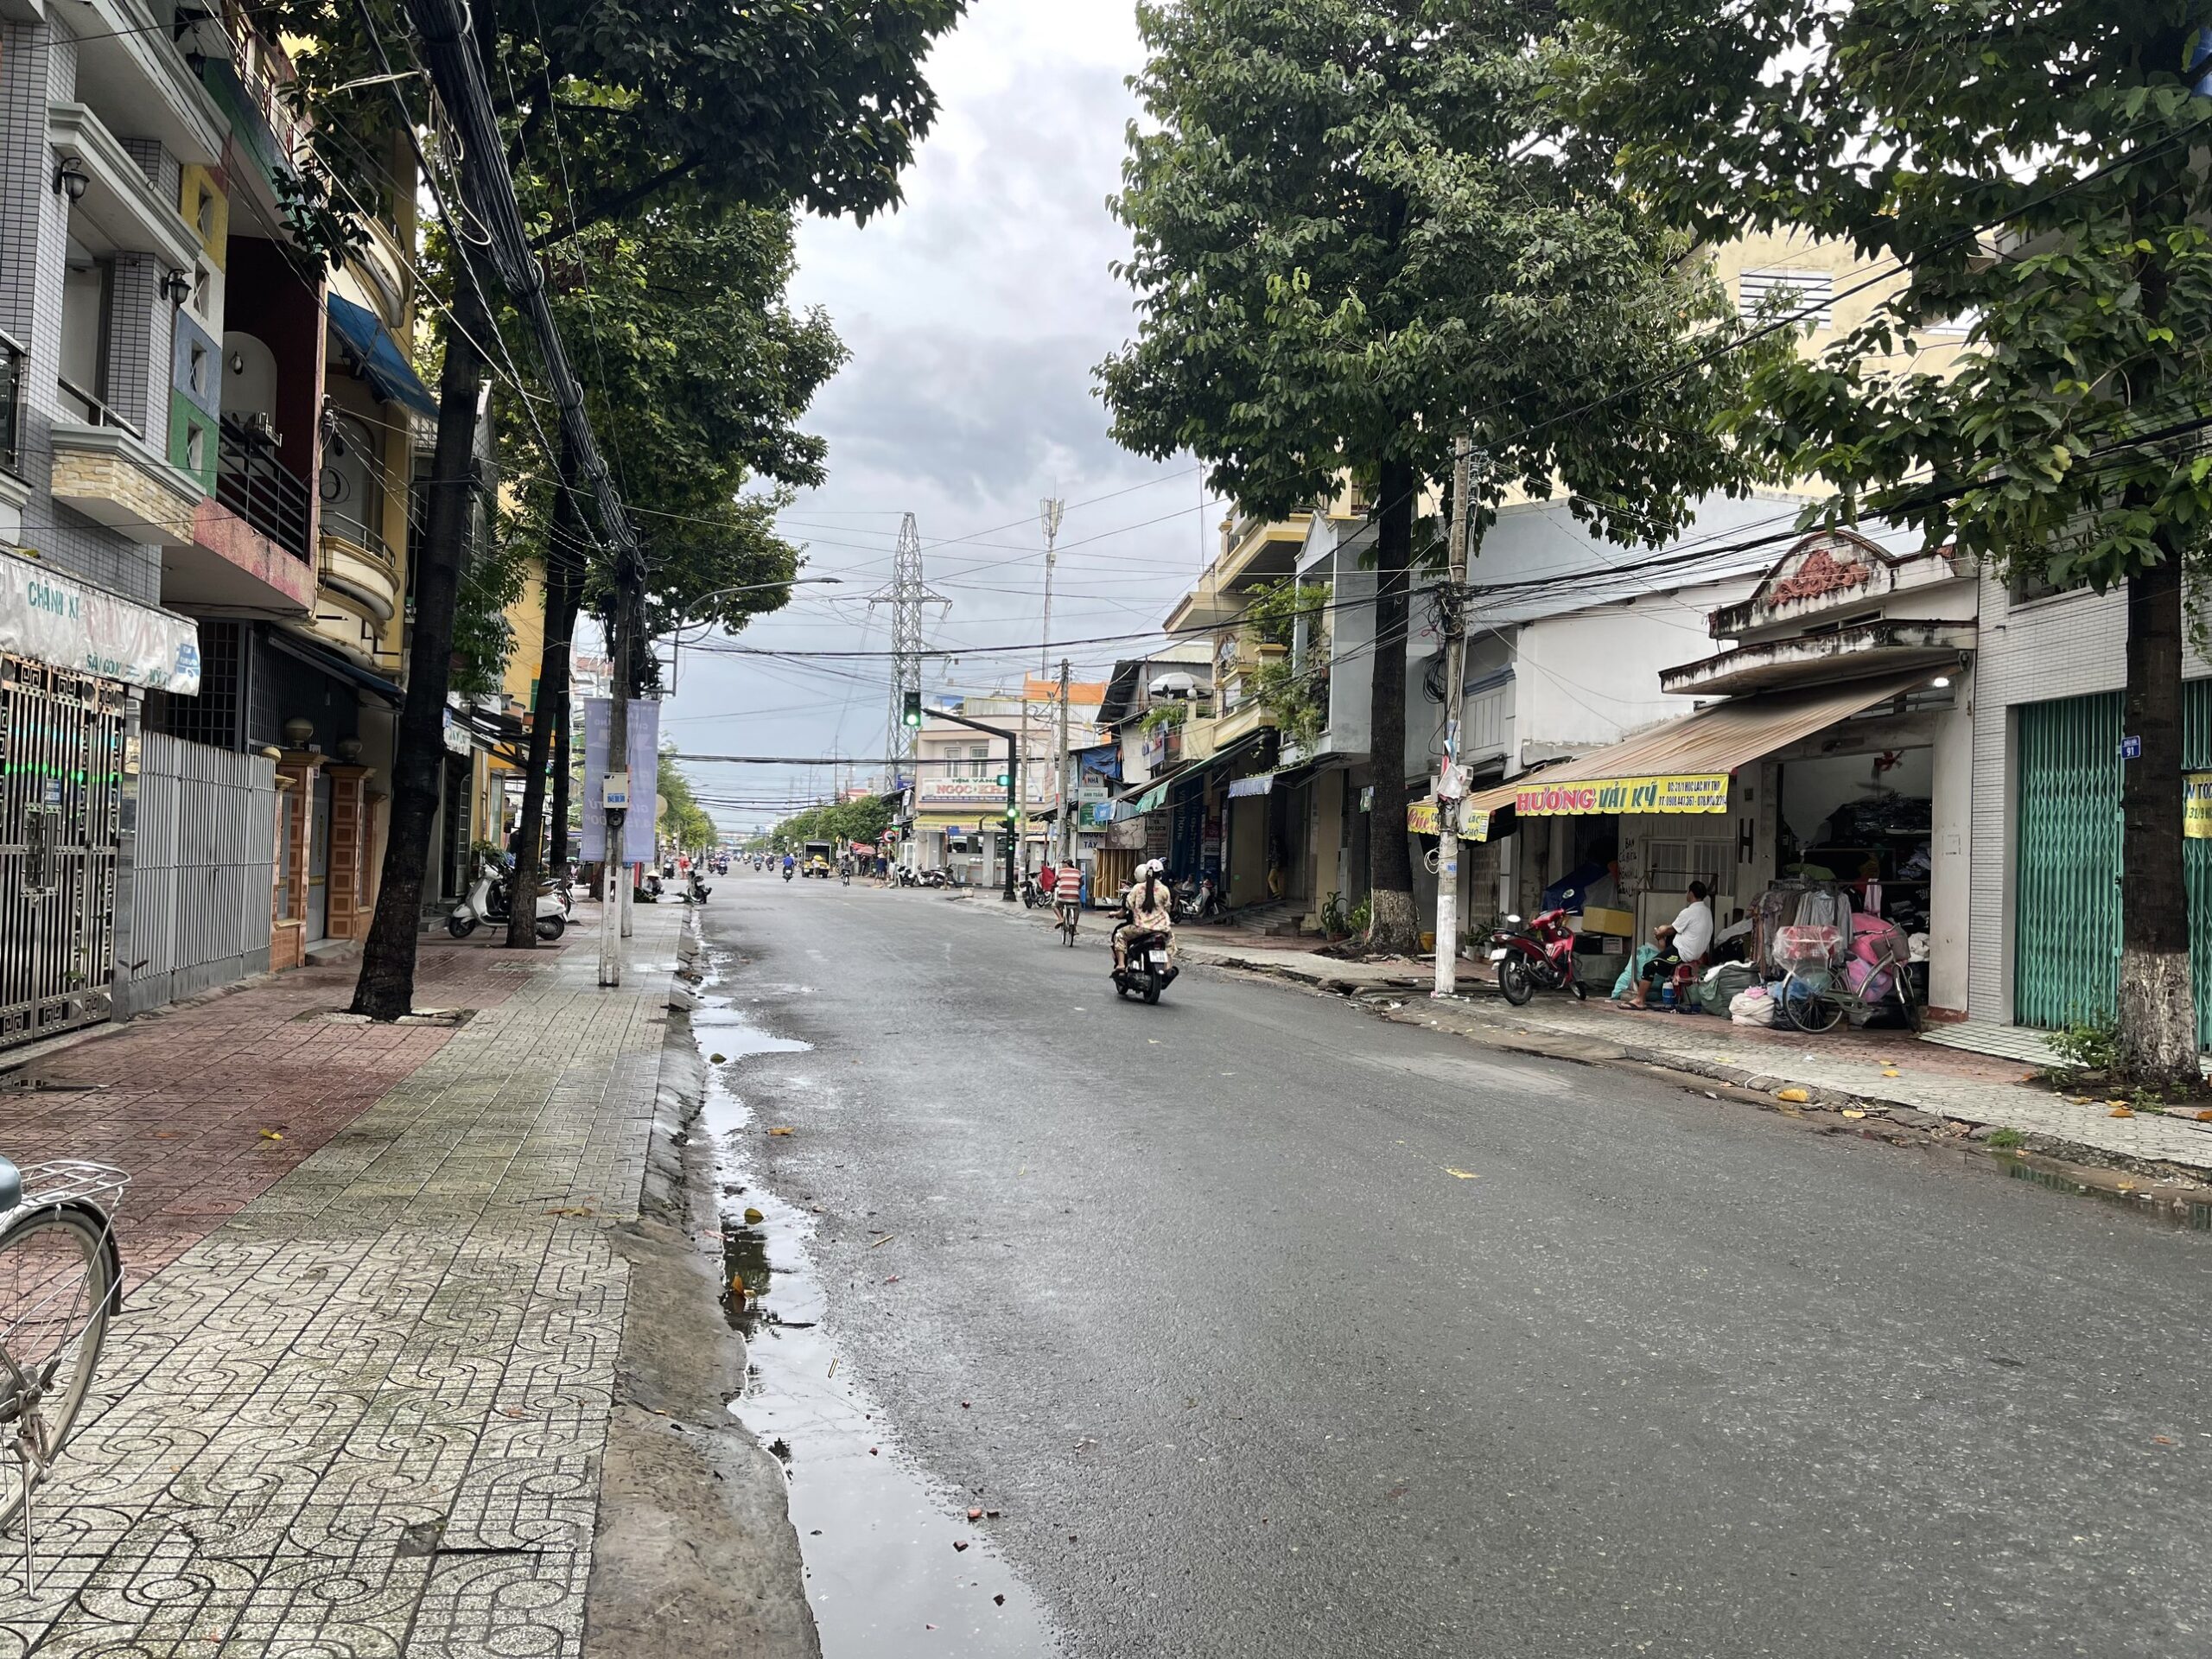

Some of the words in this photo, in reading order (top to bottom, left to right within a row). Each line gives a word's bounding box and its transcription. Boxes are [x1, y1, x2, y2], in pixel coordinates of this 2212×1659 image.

[29, 580, 64, 616] CHÀNH
[1516, 785, 1597, 811] HƯƠNG
[1599, 780, 1627, 808] VẢI
